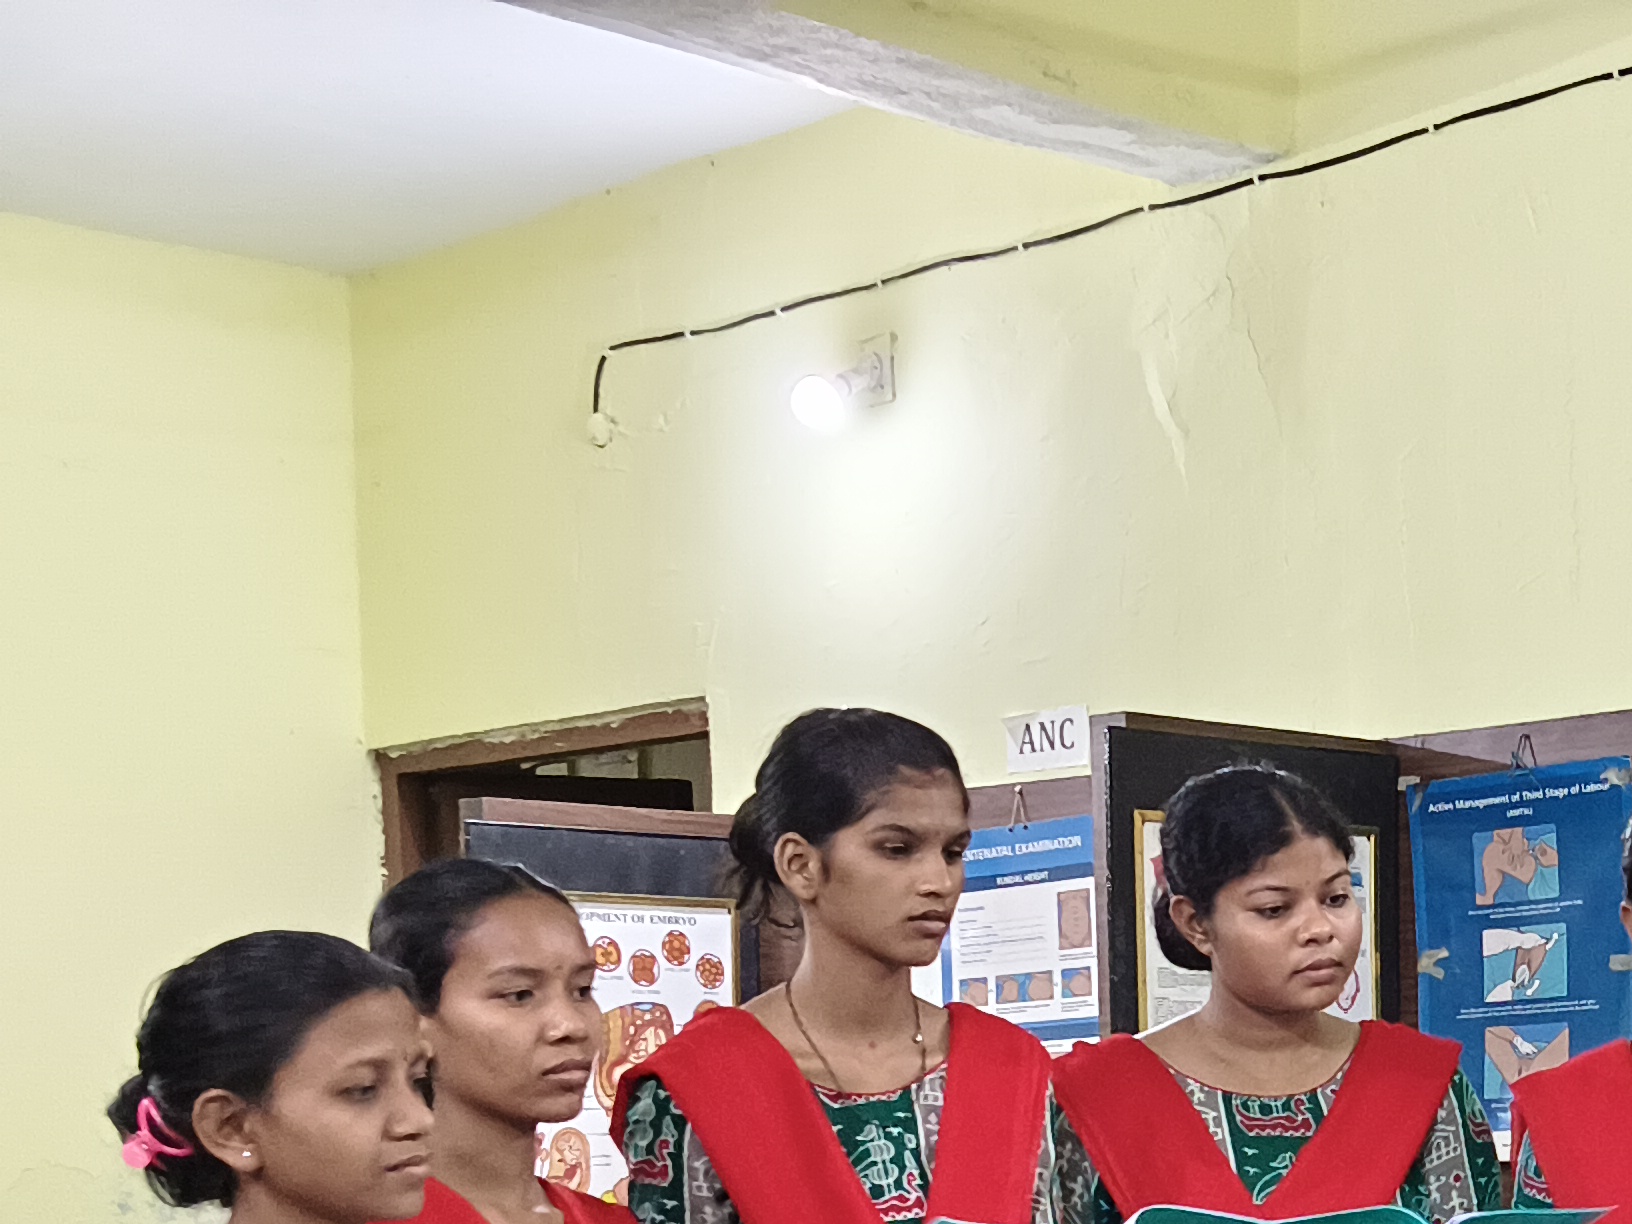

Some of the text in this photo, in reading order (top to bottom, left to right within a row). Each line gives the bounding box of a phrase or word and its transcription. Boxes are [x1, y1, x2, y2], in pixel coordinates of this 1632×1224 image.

[1019, 717, 1075, 754] ANC
[1428, 803, 1454, 813] Active
[1455, 795, 1509, 811] Management
[1511, 793, 1520, 802] of
[1522, 789, 1543, 800] Third
[1545, 786, 1568, 799] Stage
[1570, 785, 1580, 794] of
[650, 914, 697, 926] EMBRYO
